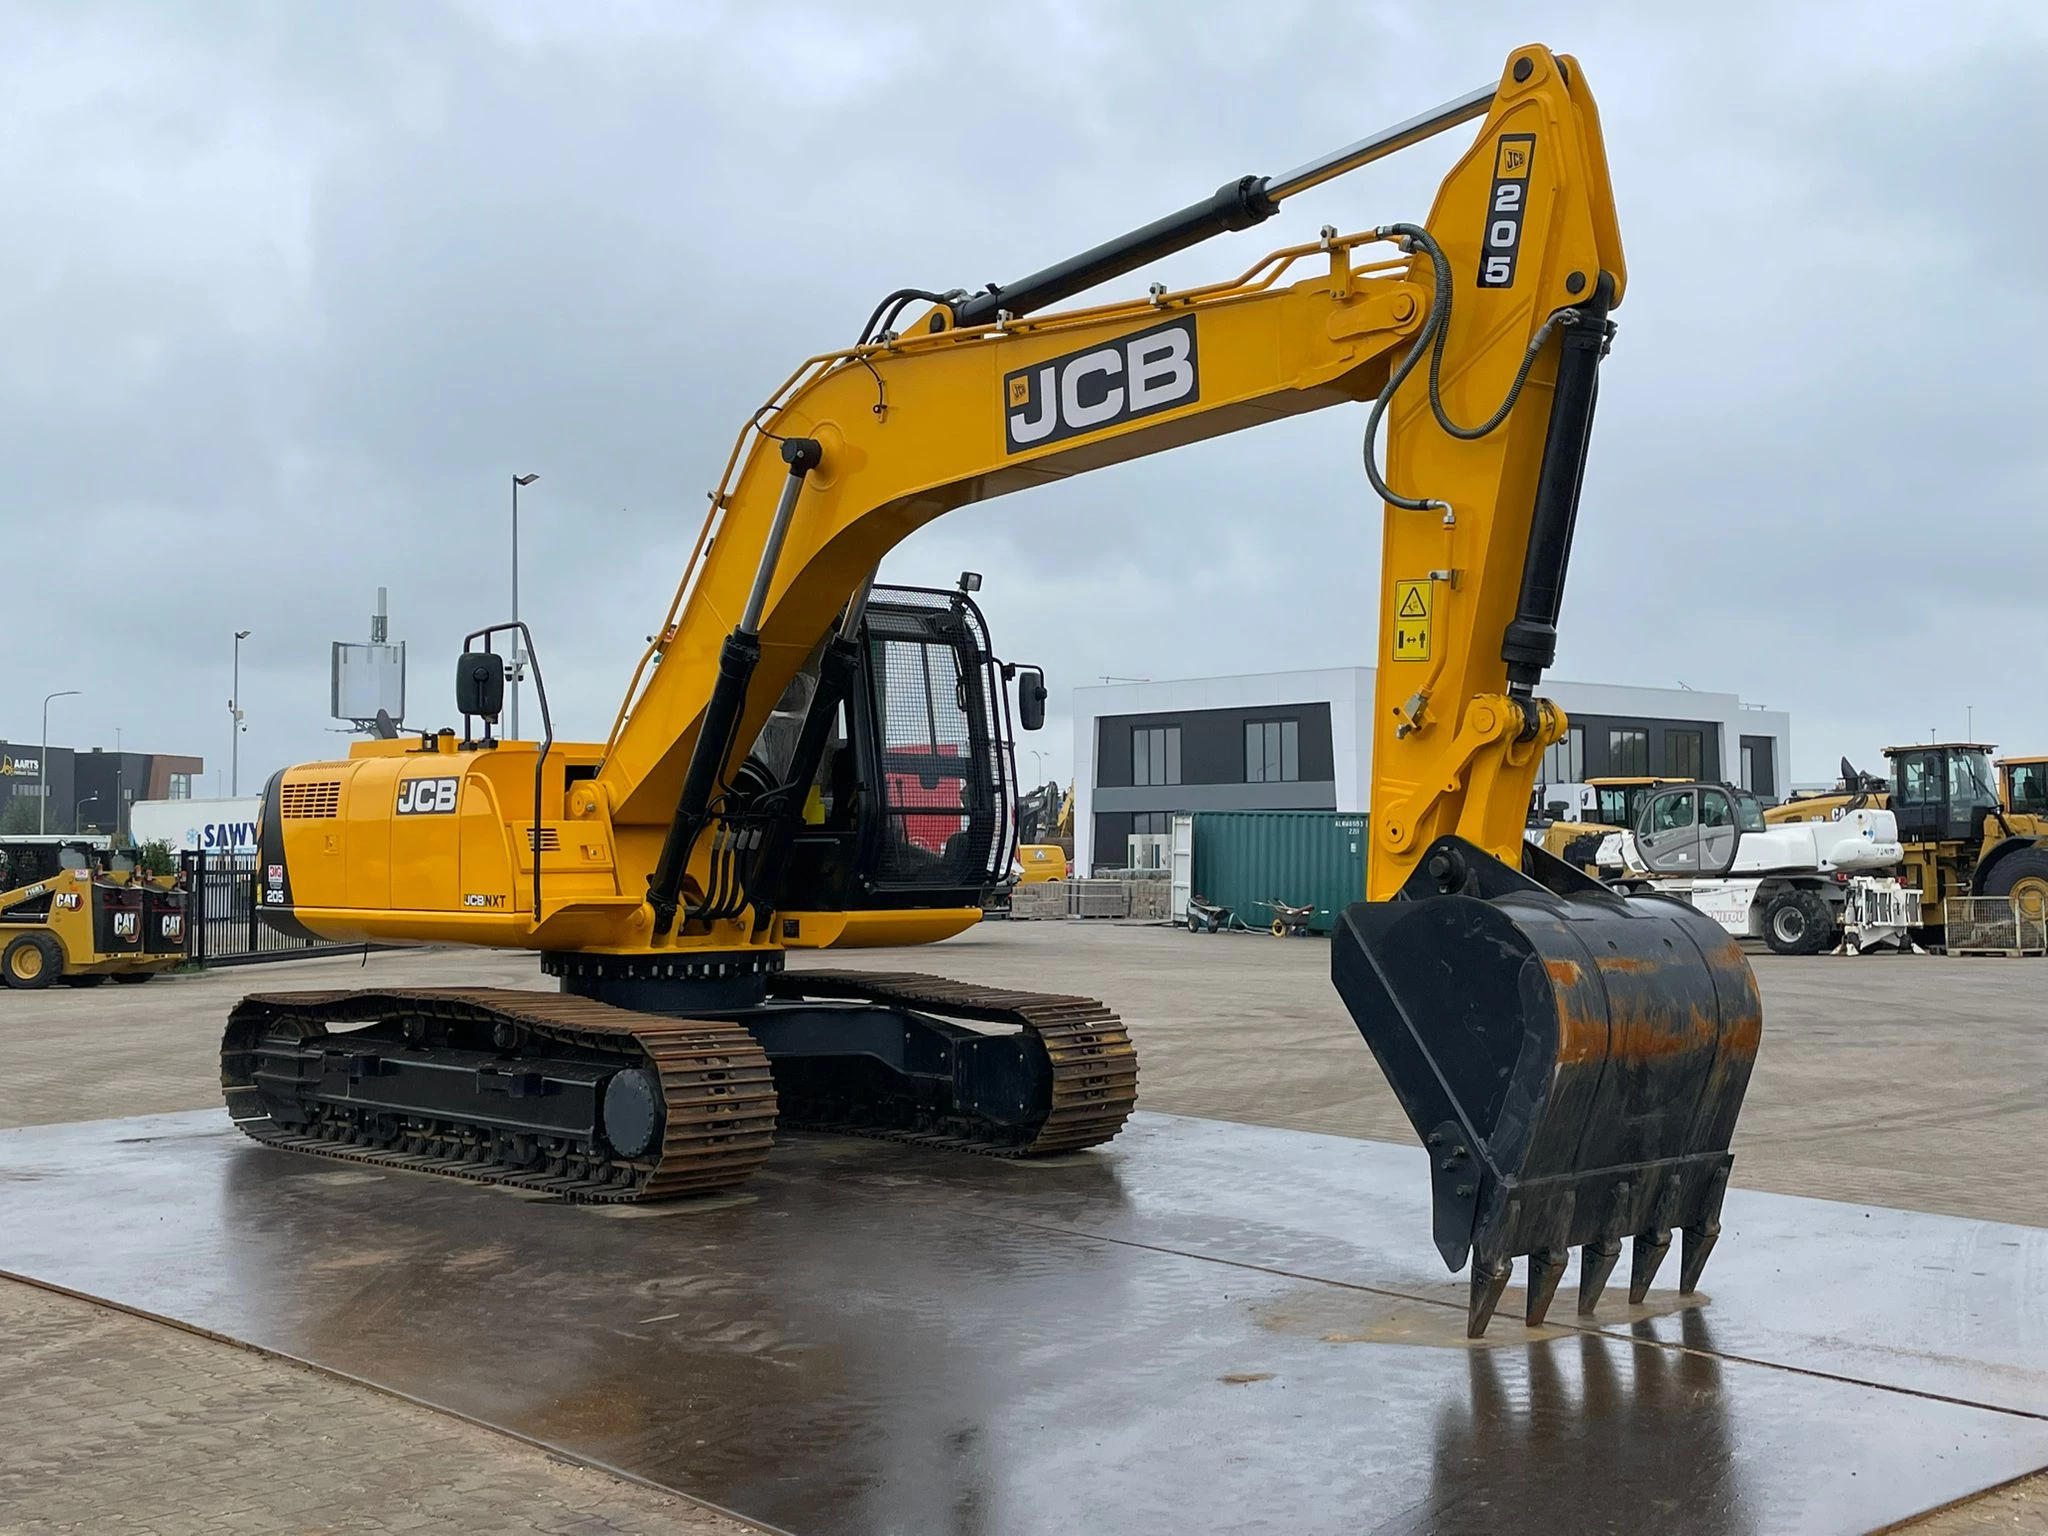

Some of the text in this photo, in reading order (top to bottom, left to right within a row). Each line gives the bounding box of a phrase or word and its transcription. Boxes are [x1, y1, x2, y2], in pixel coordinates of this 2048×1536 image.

[1507, 150, 1524, 169] JCB
[1010, 327, 1194, 444] JCB
[14, 759, 39, 769] AARTS
[398, 780, 457, 813] JCB
[56, 893, 78, 908] CAT
[267, 890, 284, 903] 205
[114, 912, 136, 935] CAT
[162, 915, 181, 936] CAT
